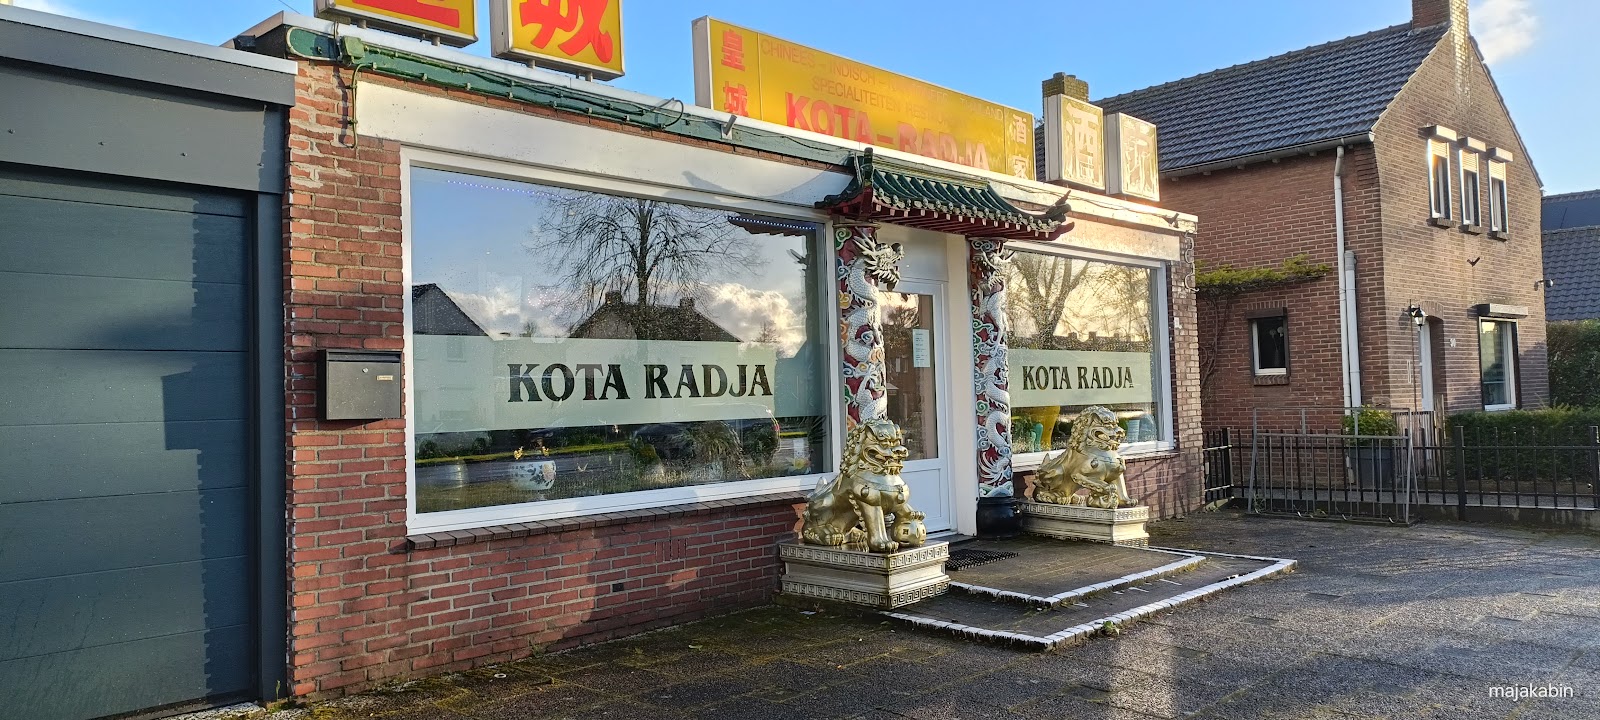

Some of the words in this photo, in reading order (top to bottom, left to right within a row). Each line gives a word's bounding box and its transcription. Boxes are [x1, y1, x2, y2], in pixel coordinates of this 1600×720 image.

[761, 39, 815, 67] CHINEES
[830, 60, 875, 85] INDISCH
[811, 75, 900, 112] SPECIALITEITEN
[507, 363, 630, 402] KOTA
[643, 364, 773, 399] RADJA
[1022, 365, 1072, 390] KOTA
[1077, 366, 1134, 389] RADJA
